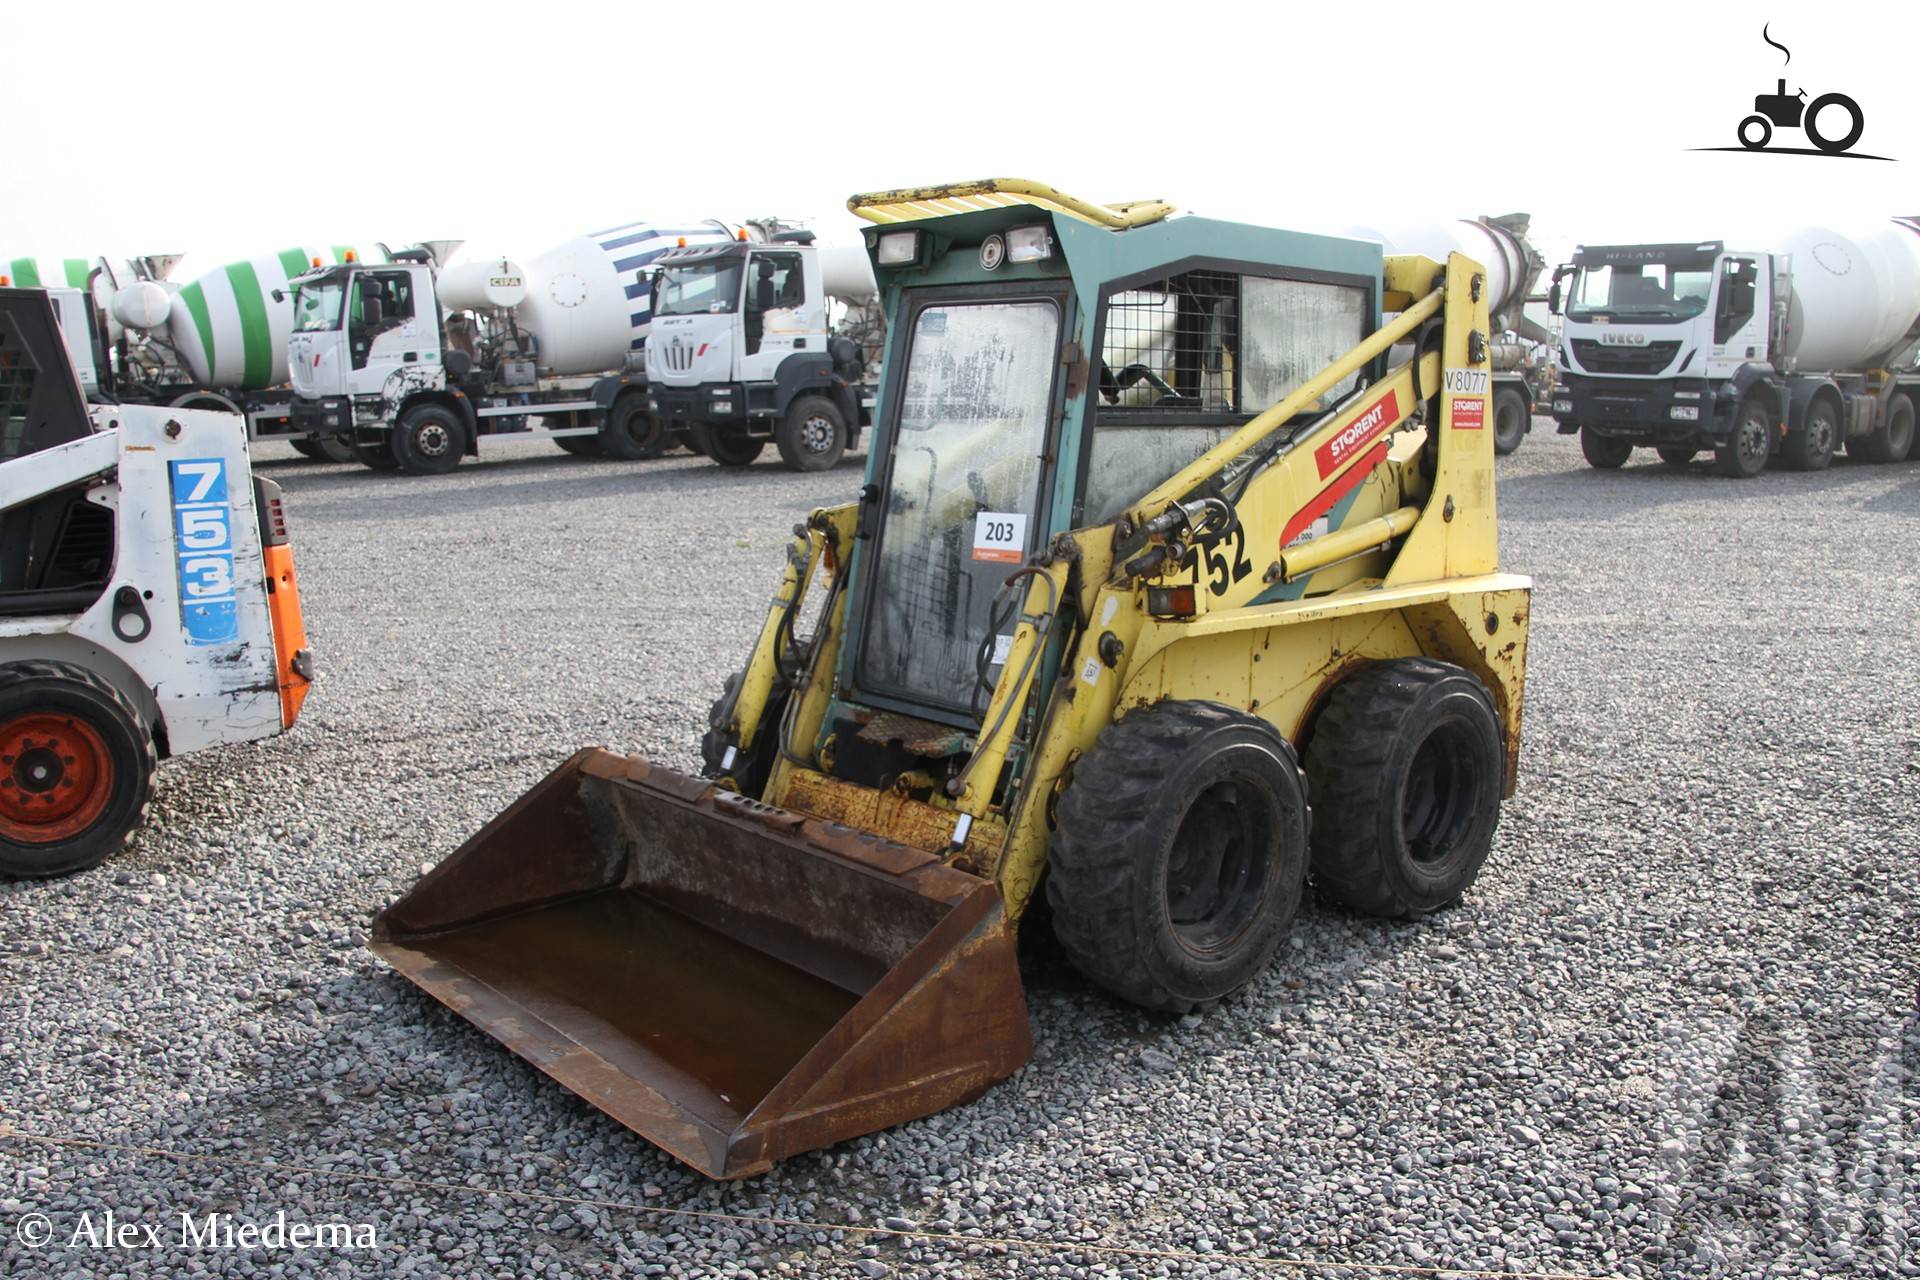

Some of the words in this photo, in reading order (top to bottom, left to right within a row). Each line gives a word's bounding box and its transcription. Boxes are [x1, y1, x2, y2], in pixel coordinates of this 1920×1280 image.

[490, 277, 521, 287] CIFA
[1602, 333, 1645, 345] IVECO
[1454, 400, 1483, 411] STORENT
[1330, 403, 1383, 457] STORENT
[177, 462, 232, 597] 753
[985, 521, 1014, 542] 203
[1180, 519, 1253, 597] 752
